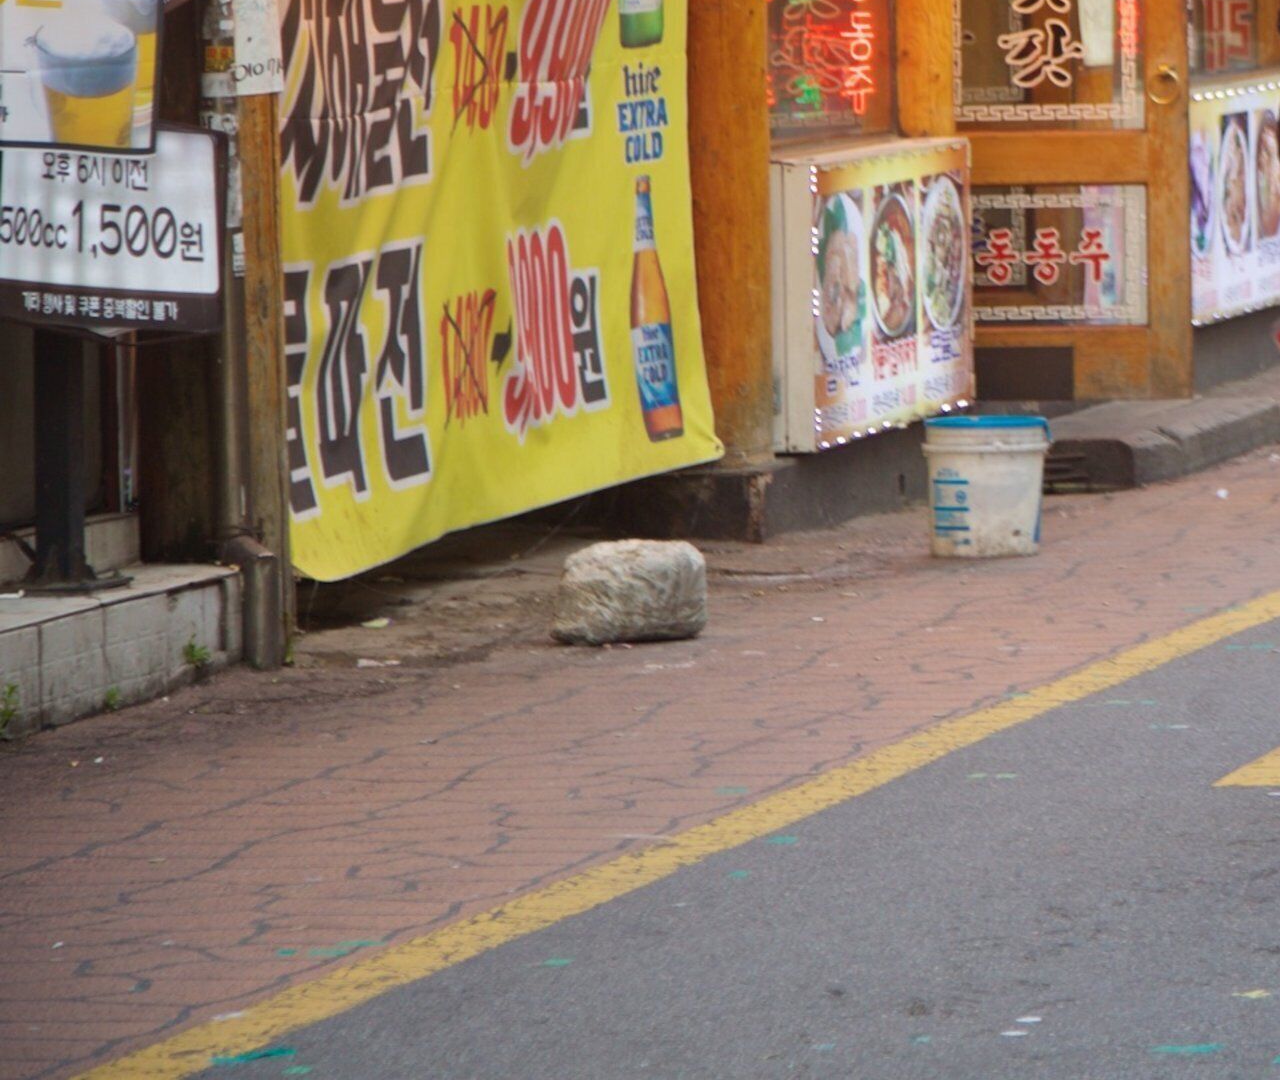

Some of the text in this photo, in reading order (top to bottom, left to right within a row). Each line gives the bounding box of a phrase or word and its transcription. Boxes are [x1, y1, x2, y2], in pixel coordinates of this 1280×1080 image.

[617, 97, 669, 132] EXTRA
[624, 131, 664, 164] COLD
[42, 151, 149, 192] 오후 6시 이전
[976, 227, 1110, 286] 동동주
